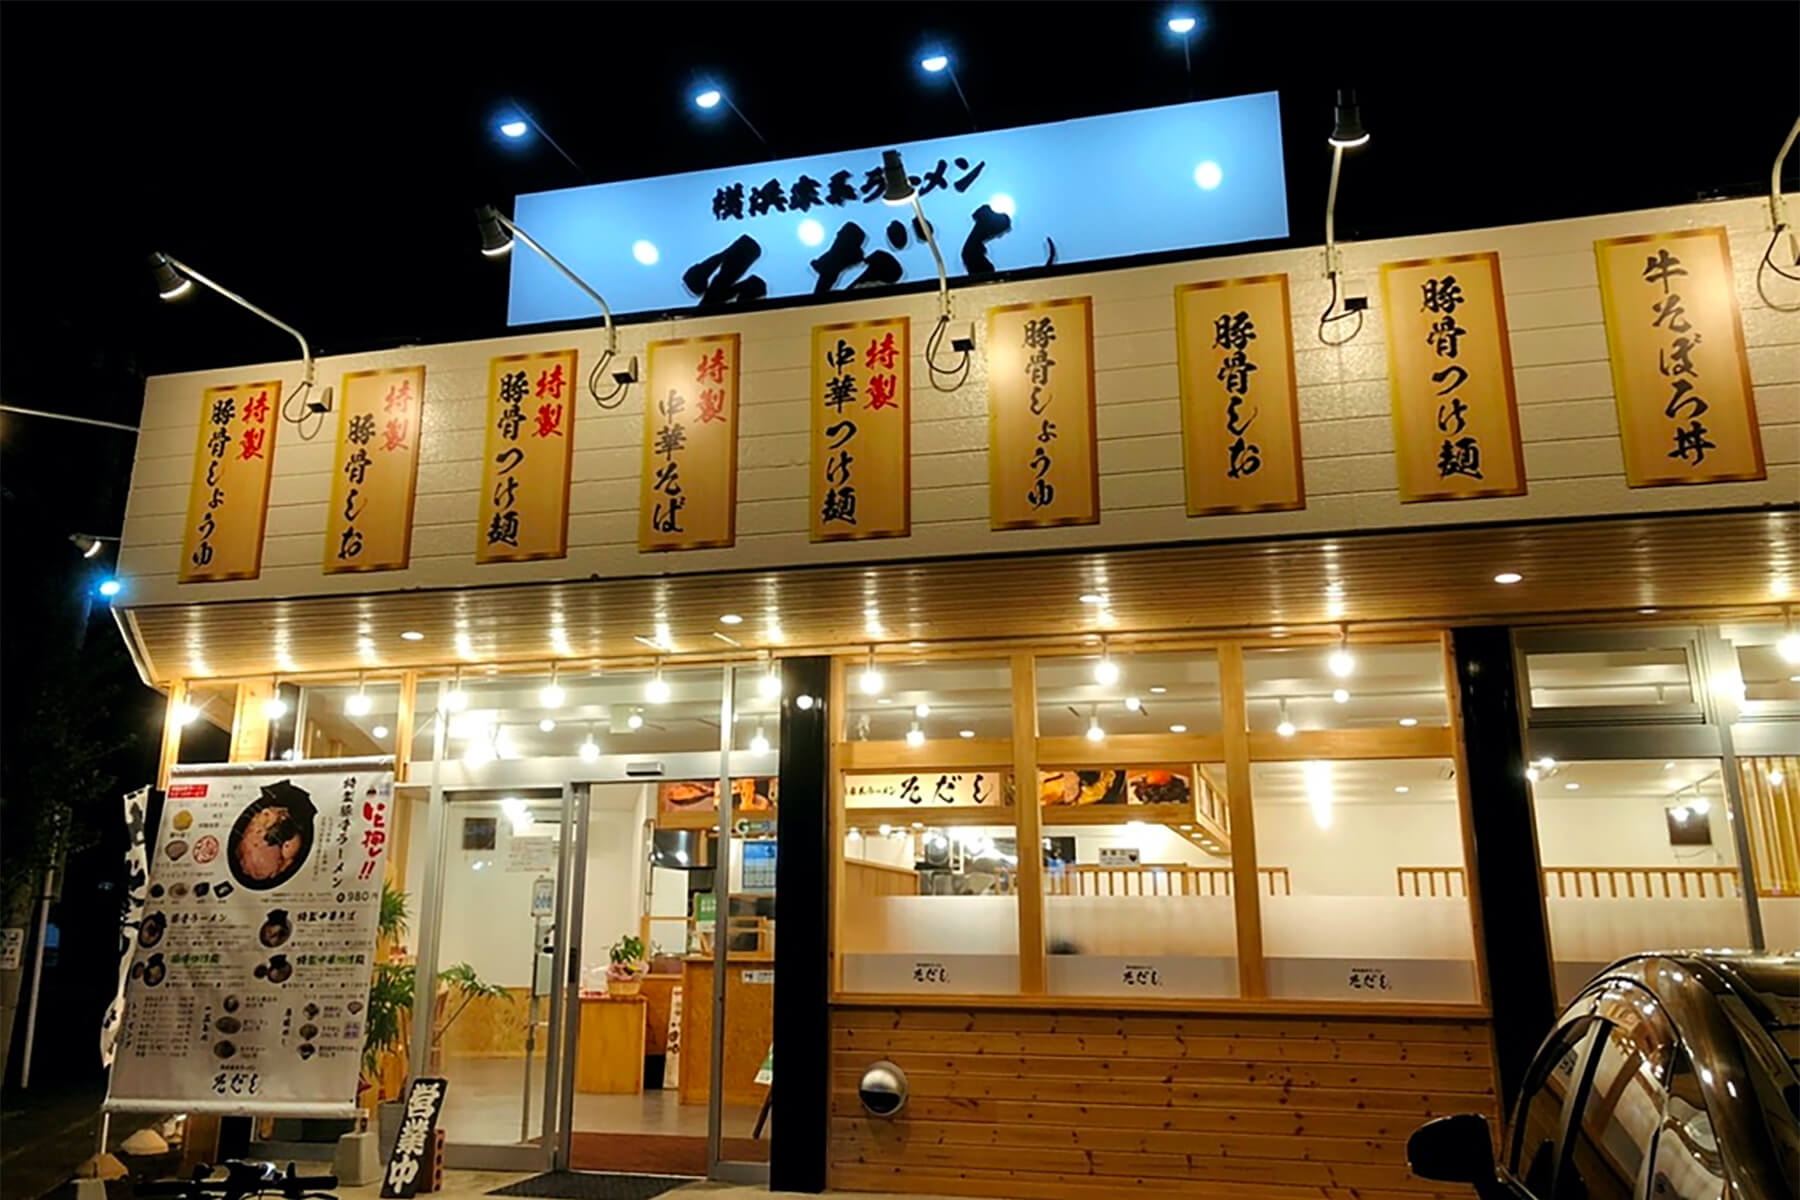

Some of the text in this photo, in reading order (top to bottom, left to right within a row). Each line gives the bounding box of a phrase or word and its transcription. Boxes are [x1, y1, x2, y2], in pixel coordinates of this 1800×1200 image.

[713, 157, 986, 221] 横浜家系ラメン
[236, 391, 270, 460] 特製
[380, 379, 414, 452] 特製
[532, 364, 568, 438] 特製
[693, 348, 729, 423] 特製
[863, 332, 899, 411] 特製
[1022, 316, 1057, 512] 豚骨しょうゆ
[1212, 310, 1261, 479] 豚骨しお
[1421, 275, 1484, 480] 豚骨つけ麺
[1642, 249, 1716, 467] 牛そぼろ丼
[191, 397, 236, 568] 豚骨しょうゆ
[337, 413, 376, 560] 豚骨しお
[486, 370, 530, 548] 豚骨つけ麺
[653, 389, 687, 533] 中華そば
[822, 338, 858, 526] 中華つけ麺
[388, 1083, 441, 1194] 営業中
